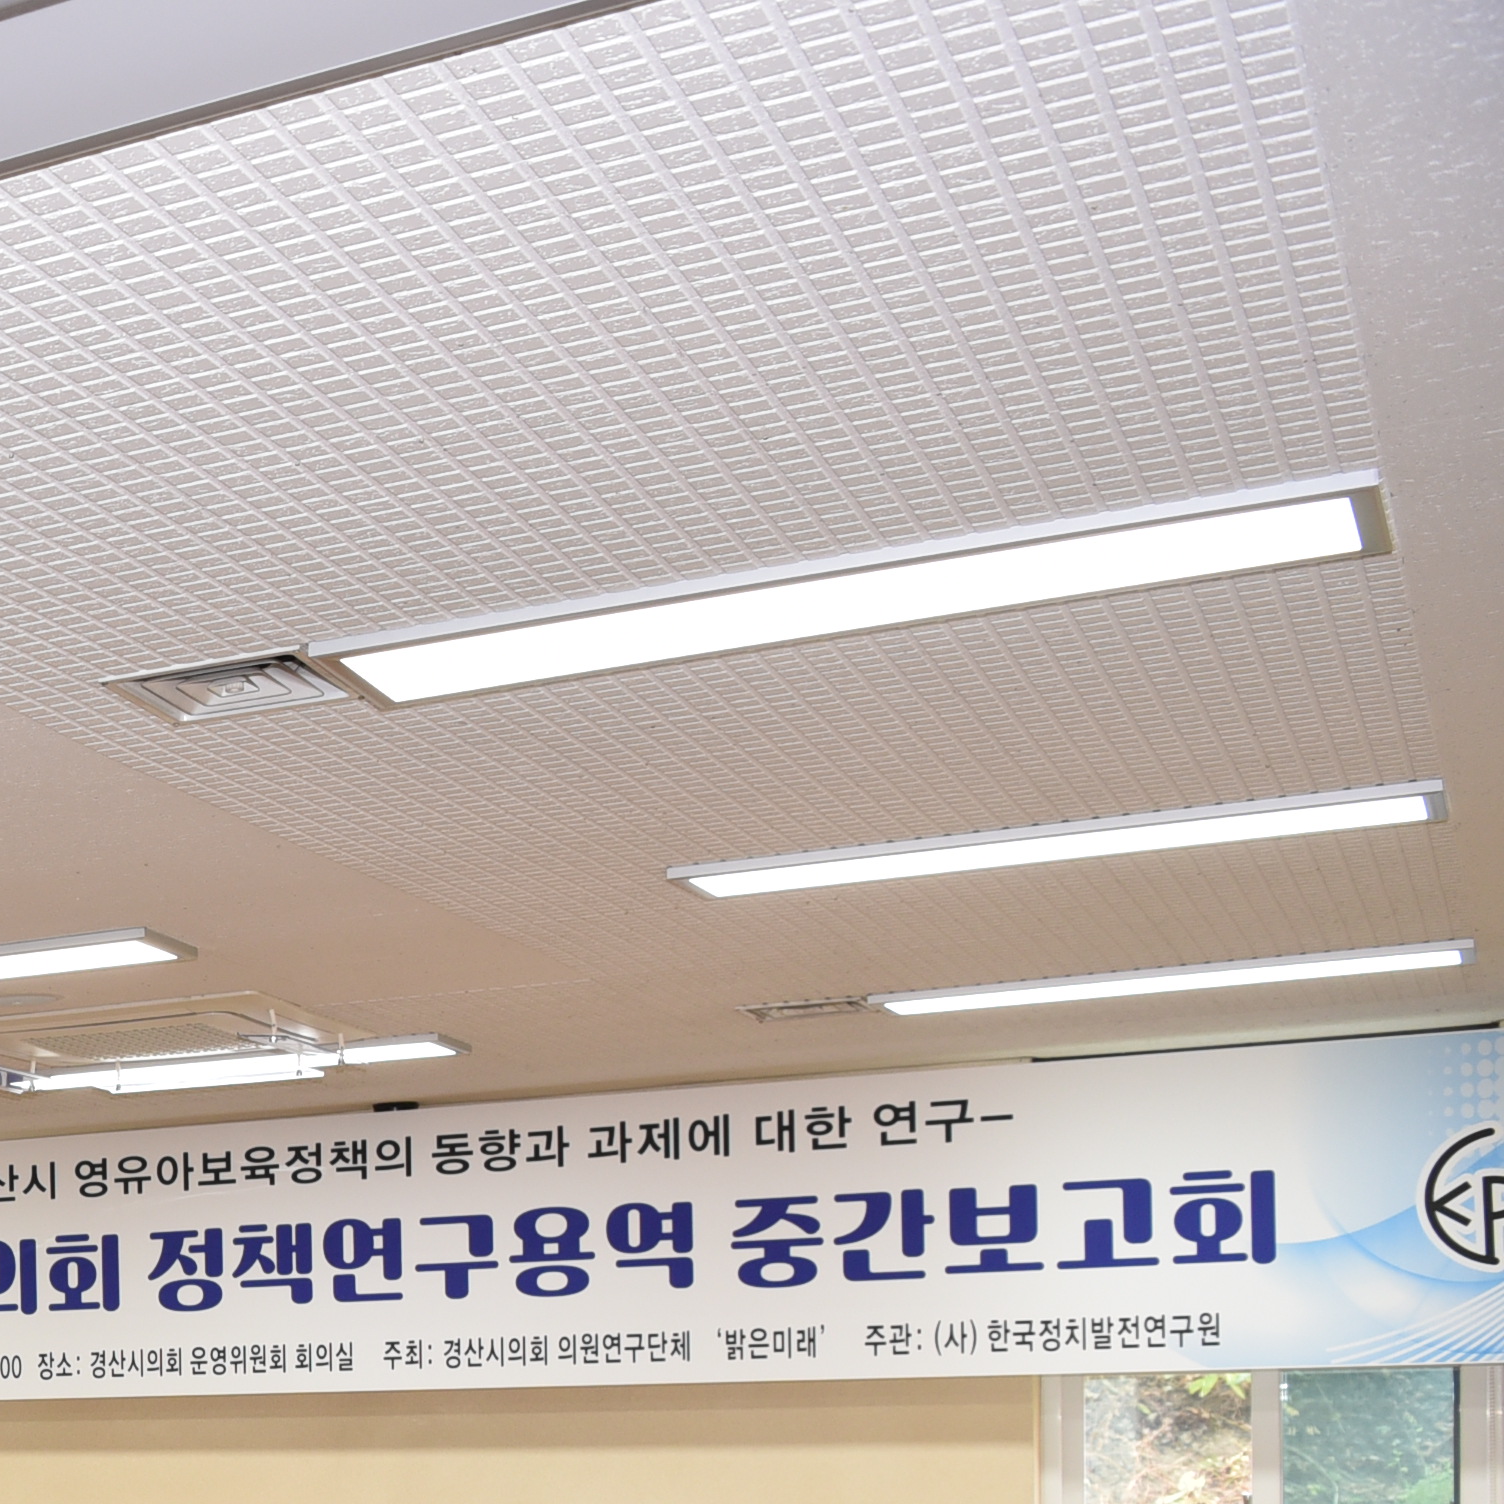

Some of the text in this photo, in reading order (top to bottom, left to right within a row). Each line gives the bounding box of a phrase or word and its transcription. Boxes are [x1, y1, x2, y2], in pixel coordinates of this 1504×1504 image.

[74, 1135, 414, 1199] 영유아보육정책의
[431, 1124, 571, 1176] 동향과
[587, 1113, 730, 1164] 과제에
[754, 1105, 853, 1154] 대한
[147, 1201, 694, 1312] 정책연구용역
[730, 1169, 1277, 1289] 중간보고회
[37, 1351, 81, 1381] 장소:
[90, 1347, 182, 1379] 경산시의회
[189, 1344, 287, 1376] 운영위원회
[295, 1341, 353, 1373] 회의실
[383, 1339, 432, 1370] 주최:
[443, 1335, 548, 1369] 경산시의회
[557, 1330, 691, 1365] 의원연구단체
[864, 1323, 922, 1357] 주관:
[987, 1312, 1220, 1353] 한국정치발전연구원
